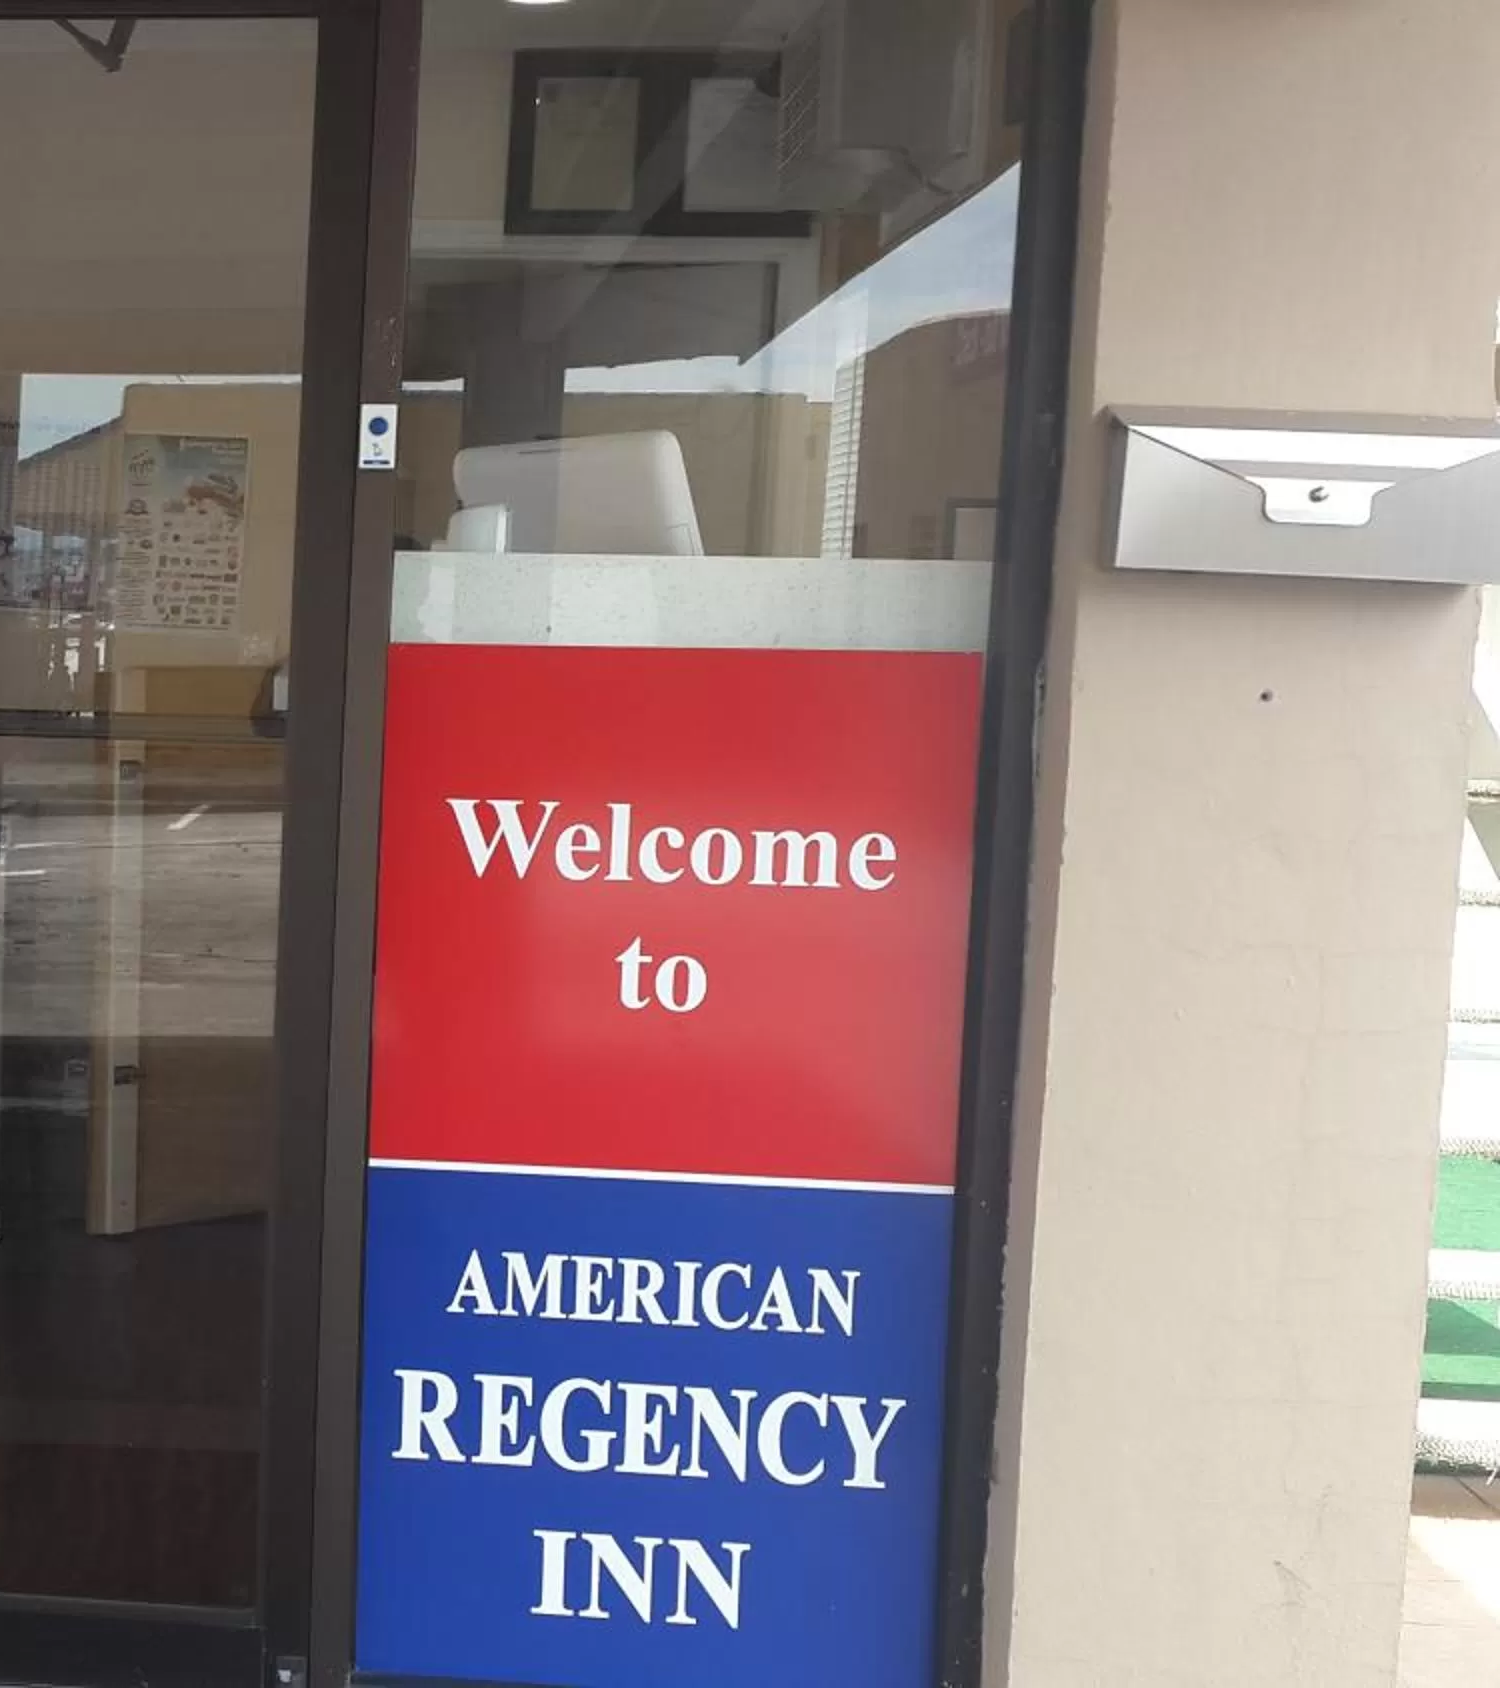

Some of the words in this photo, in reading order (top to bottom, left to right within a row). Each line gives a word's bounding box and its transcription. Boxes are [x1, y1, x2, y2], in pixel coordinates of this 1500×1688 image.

[444, 797, 898, 892] Welcome
[614, 935, 708, 1013] to
[445, 1248, 862, 1337] AMERICAN
[391, 1368, 907, 1490] REGENCY
[530, 1528, 752, 1630] INN
